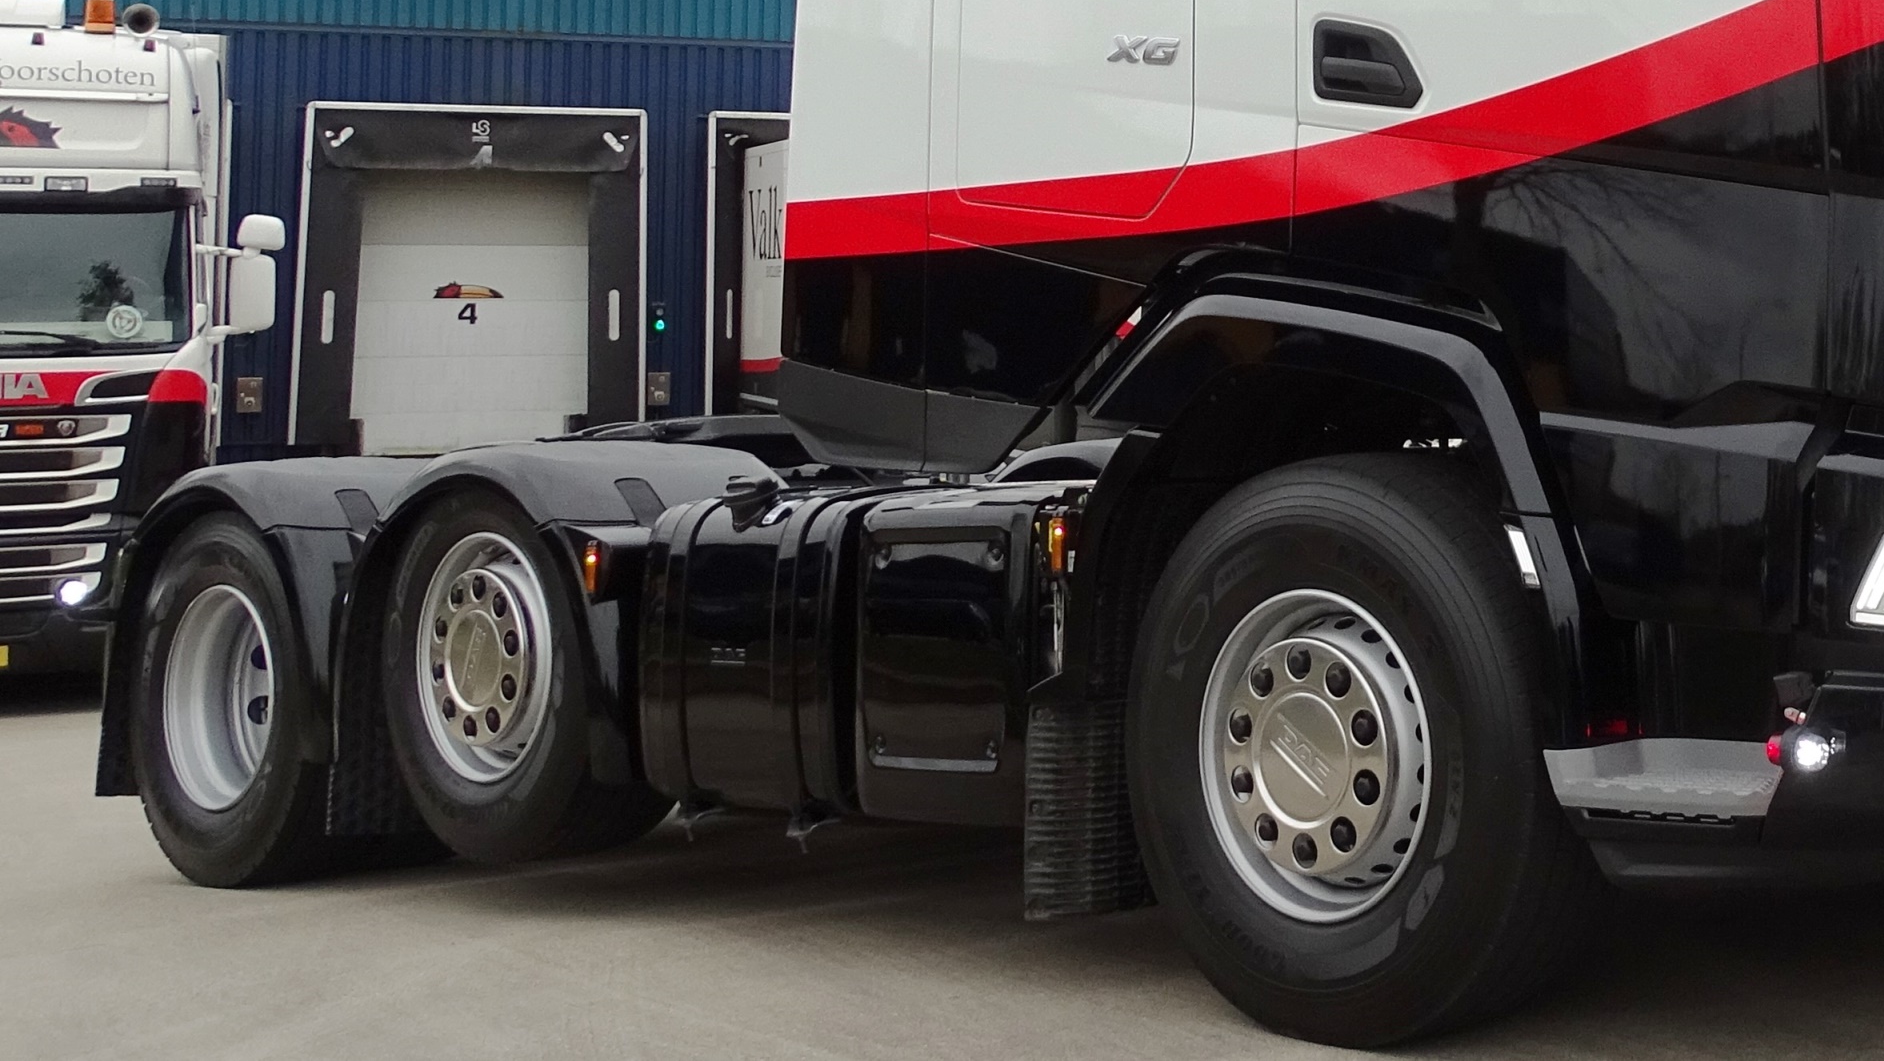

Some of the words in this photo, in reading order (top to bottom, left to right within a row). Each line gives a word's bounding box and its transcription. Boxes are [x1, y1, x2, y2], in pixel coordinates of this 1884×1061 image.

[1106, 34, 1180, 66] XG
[0, 59, 156, 87] oorschoten
[749, 185, 783, 261] Valk
[458, 302, 478, 325] 4
